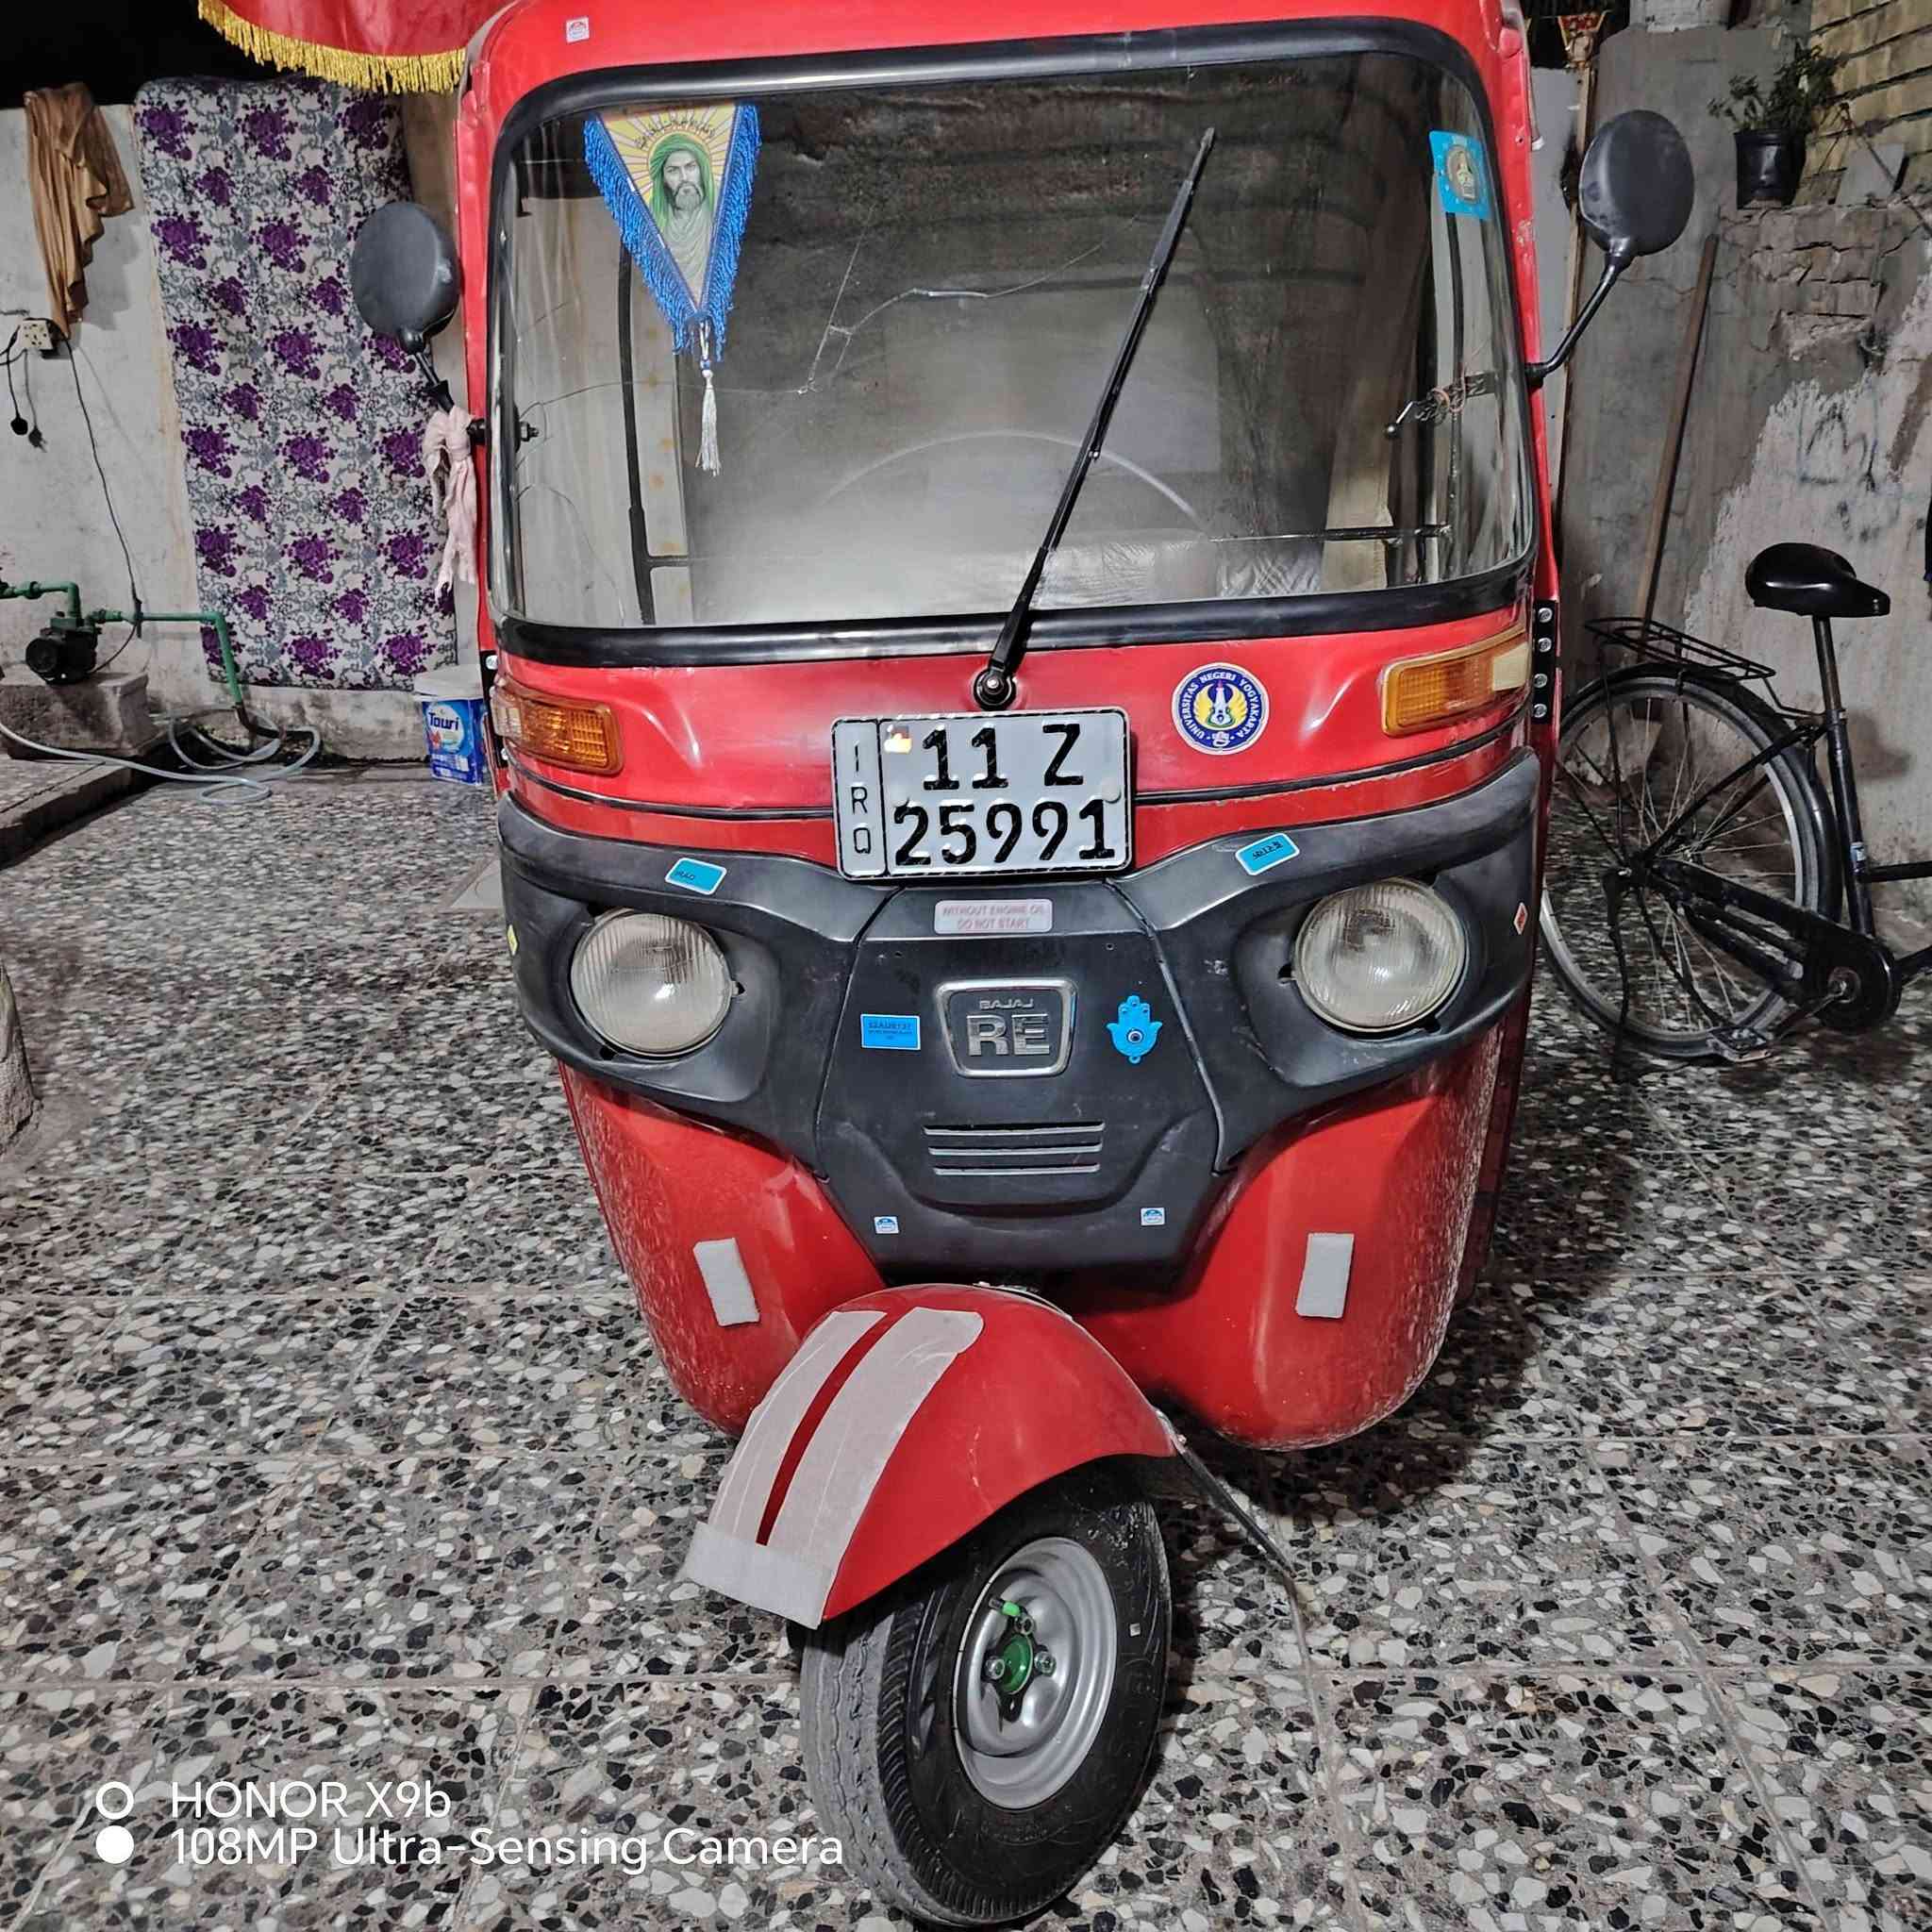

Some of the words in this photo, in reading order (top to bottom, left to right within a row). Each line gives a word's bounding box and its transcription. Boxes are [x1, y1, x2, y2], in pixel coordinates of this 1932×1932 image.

[1199, 671, 1236, 683] NEGERI
[923, 724, 1008, 791] 11
[1041, 723, 1084, 786] Z
[893, 798, 1115, 866] 25991
[974, 918, 994, 928] NOT
[979, 998, 1034, 1009] BAJAJ
[966, 1013, 1050, 1056] RE
